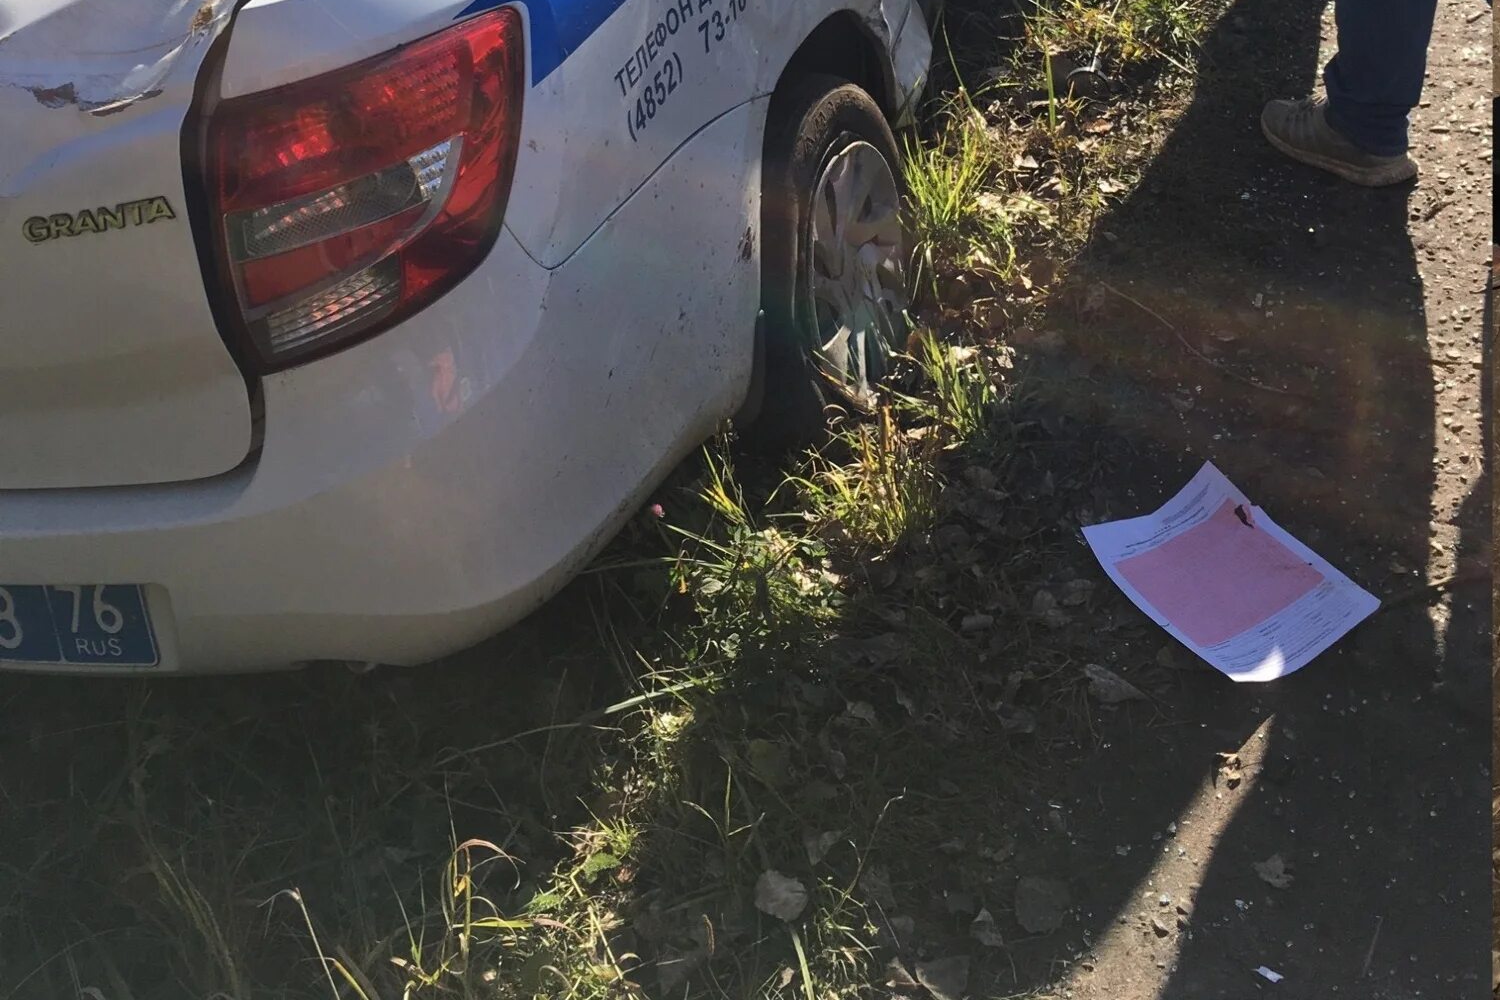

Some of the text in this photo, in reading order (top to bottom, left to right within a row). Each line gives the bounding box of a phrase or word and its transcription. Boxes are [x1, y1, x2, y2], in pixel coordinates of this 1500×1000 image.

[627, 52, 683, 143] (4852)
[22, 196, 176, 243] GRANTA
[53, 584, 124, 634] 76
[75, 637, 122, 656] RUS
